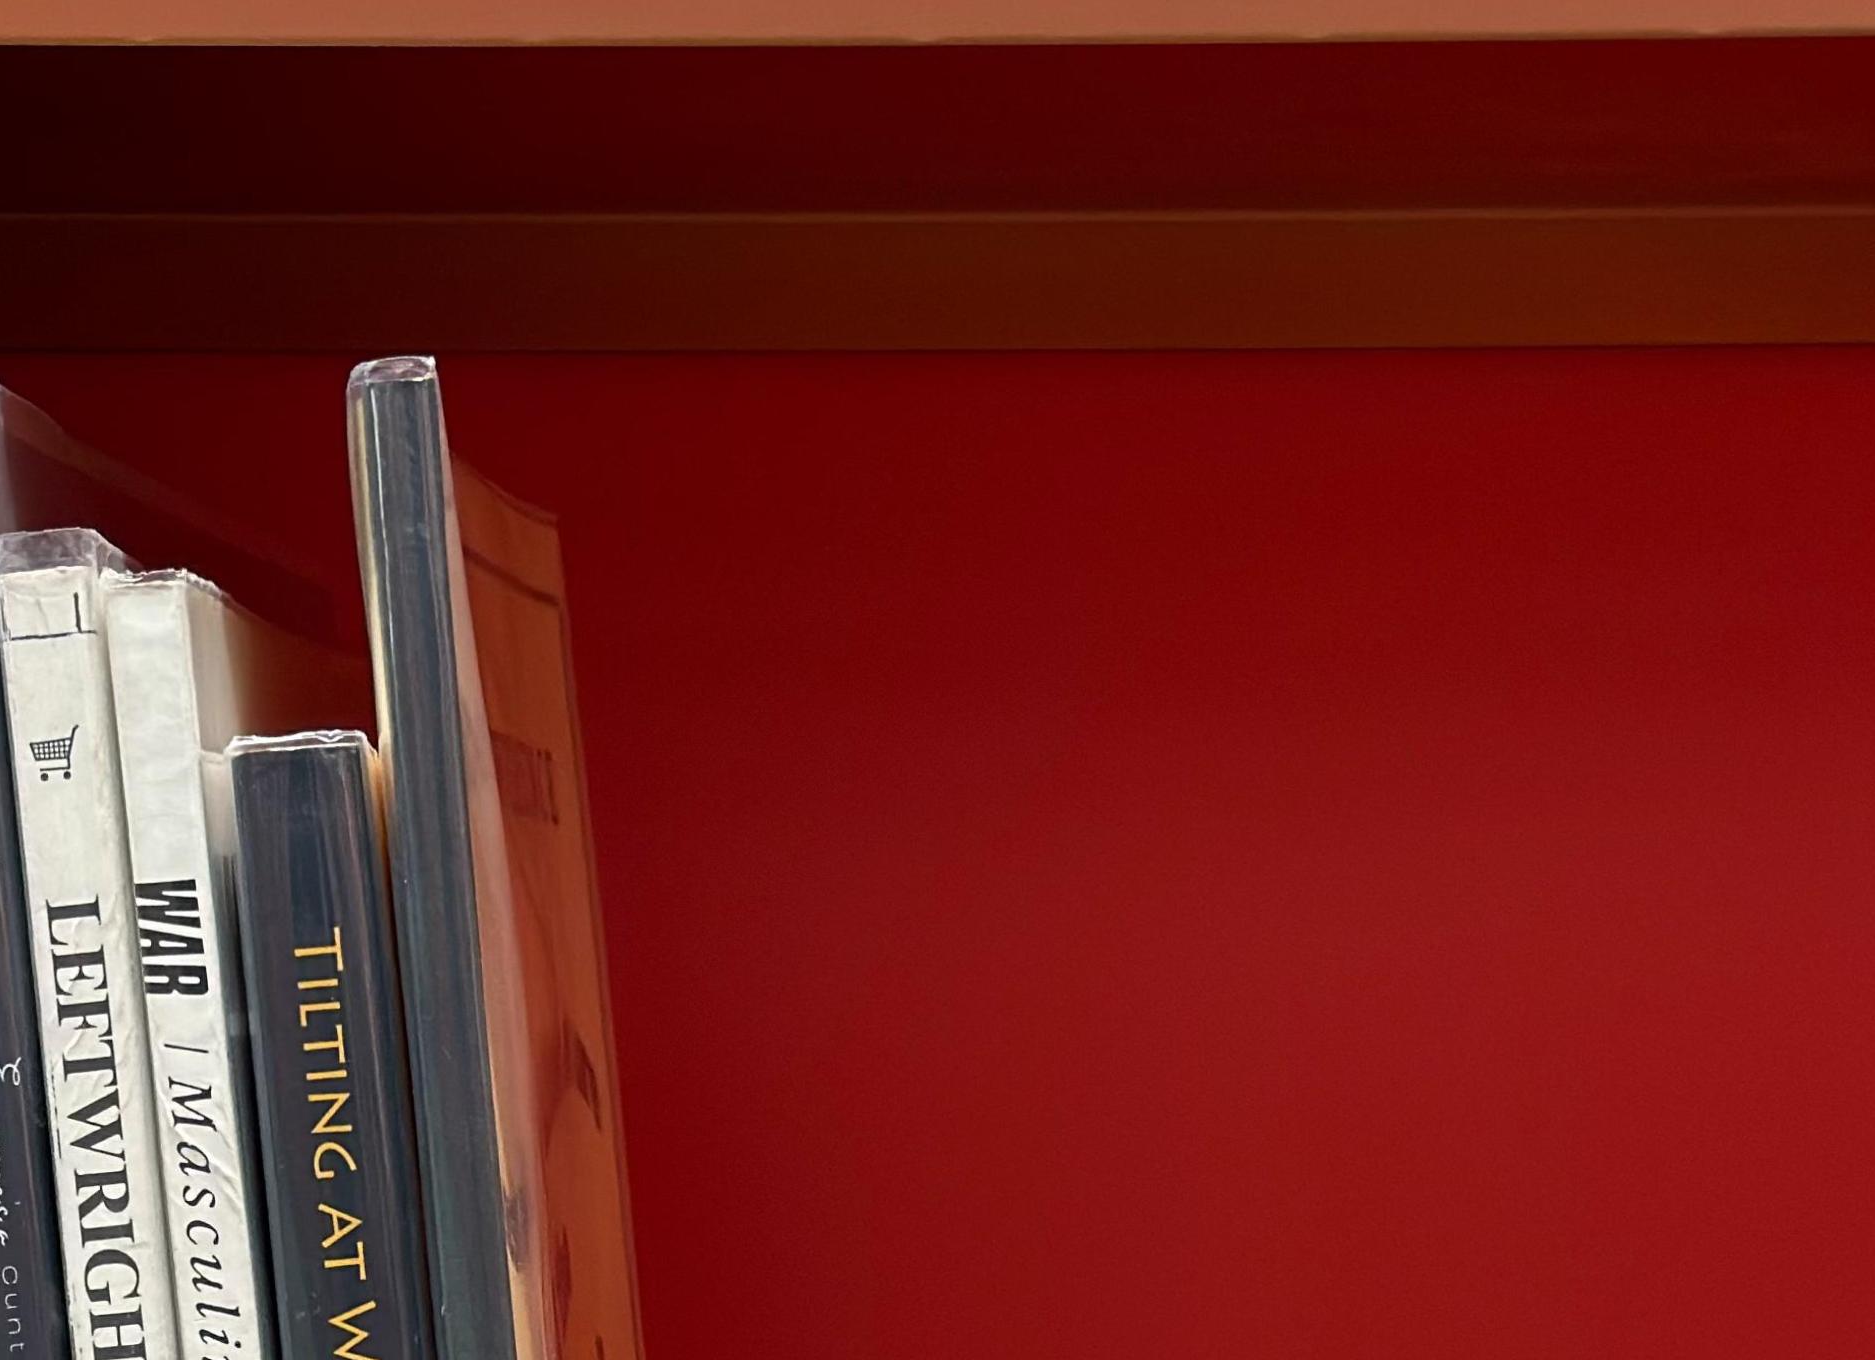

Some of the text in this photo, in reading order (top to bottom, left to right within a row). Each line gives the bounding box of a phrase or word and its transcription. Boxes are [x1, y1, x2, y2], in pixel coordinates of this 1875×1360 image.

[134, 879, 209, 996] WAR
[293, 926, 358, 1181] TILTING
[318, 1203, 367, 1281] AT
[1, 1265, 25, 1353] cunt
